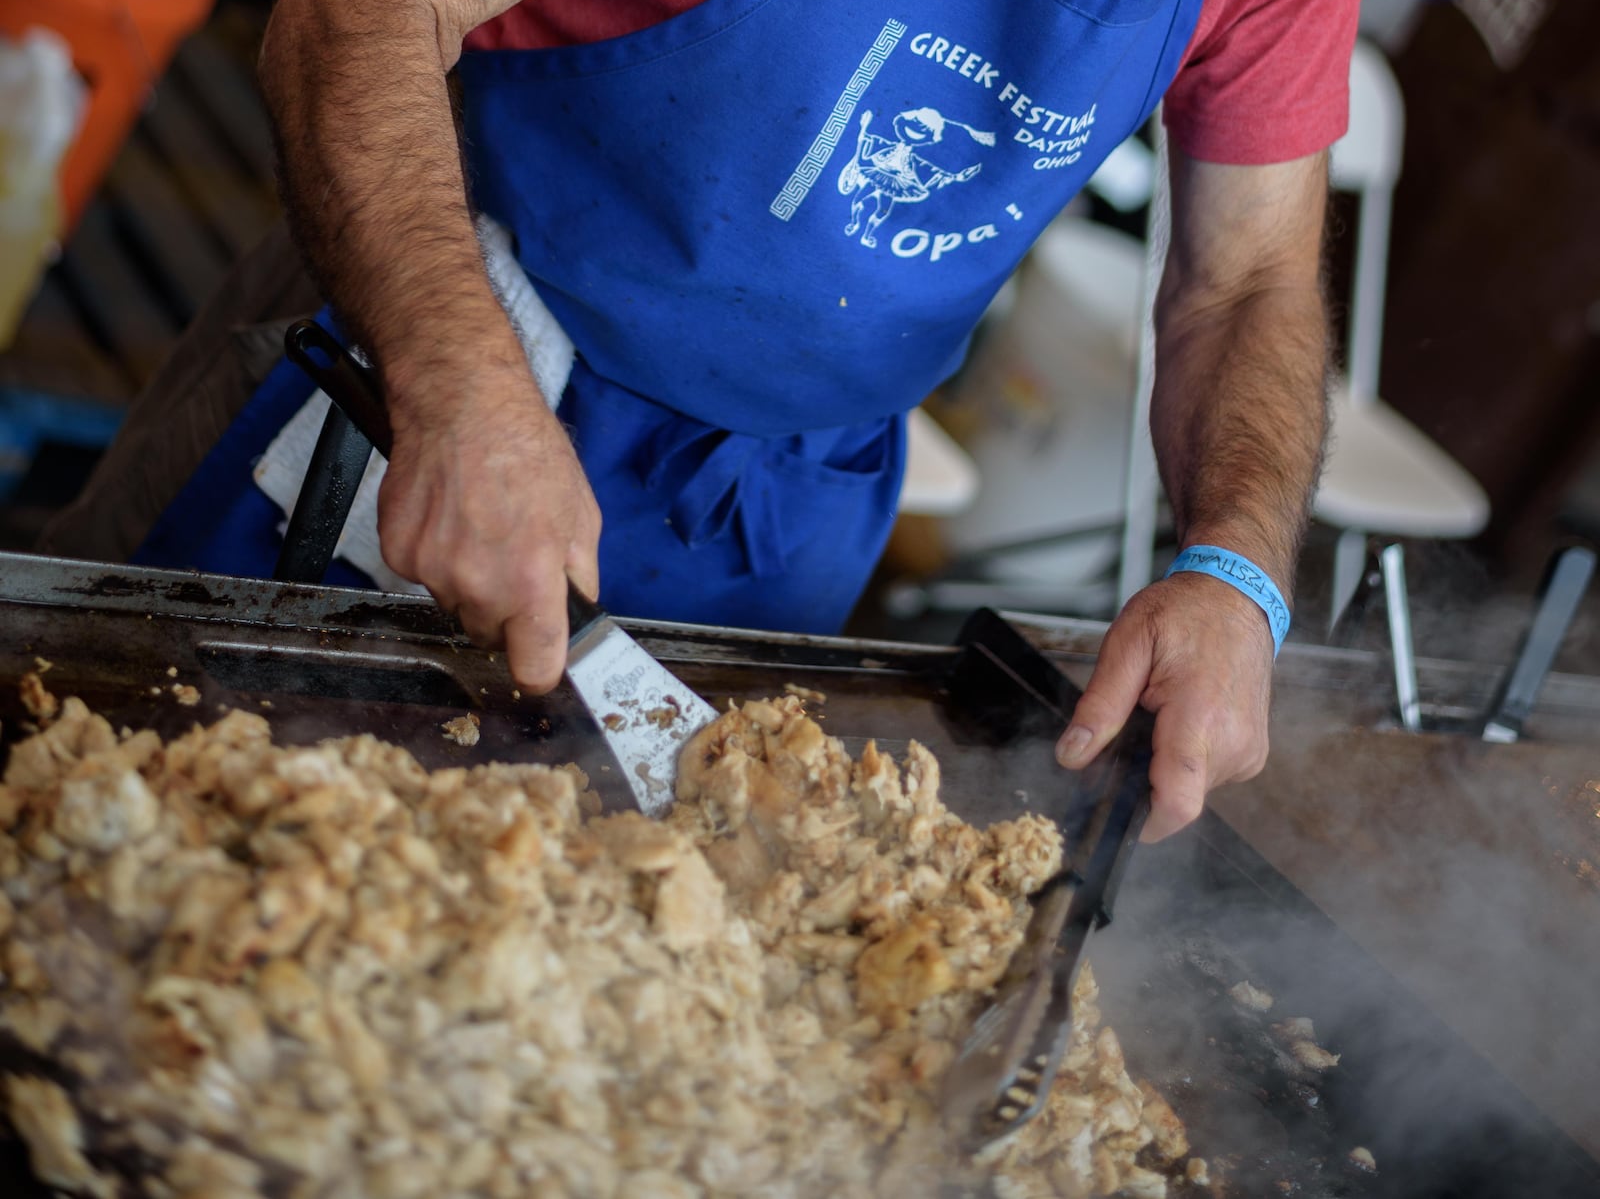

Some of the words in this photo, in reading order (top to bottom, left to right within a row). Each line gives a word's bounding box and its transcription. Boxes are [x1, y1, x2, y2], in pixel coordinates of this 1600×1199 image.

[910, 32, 1000, 89] GREEK
[998, 82, 1097, 136] FESTIVAL
[1013, 127, 1091, 153] DAYTON
[1032, 151, 1082, 171] OHIO
